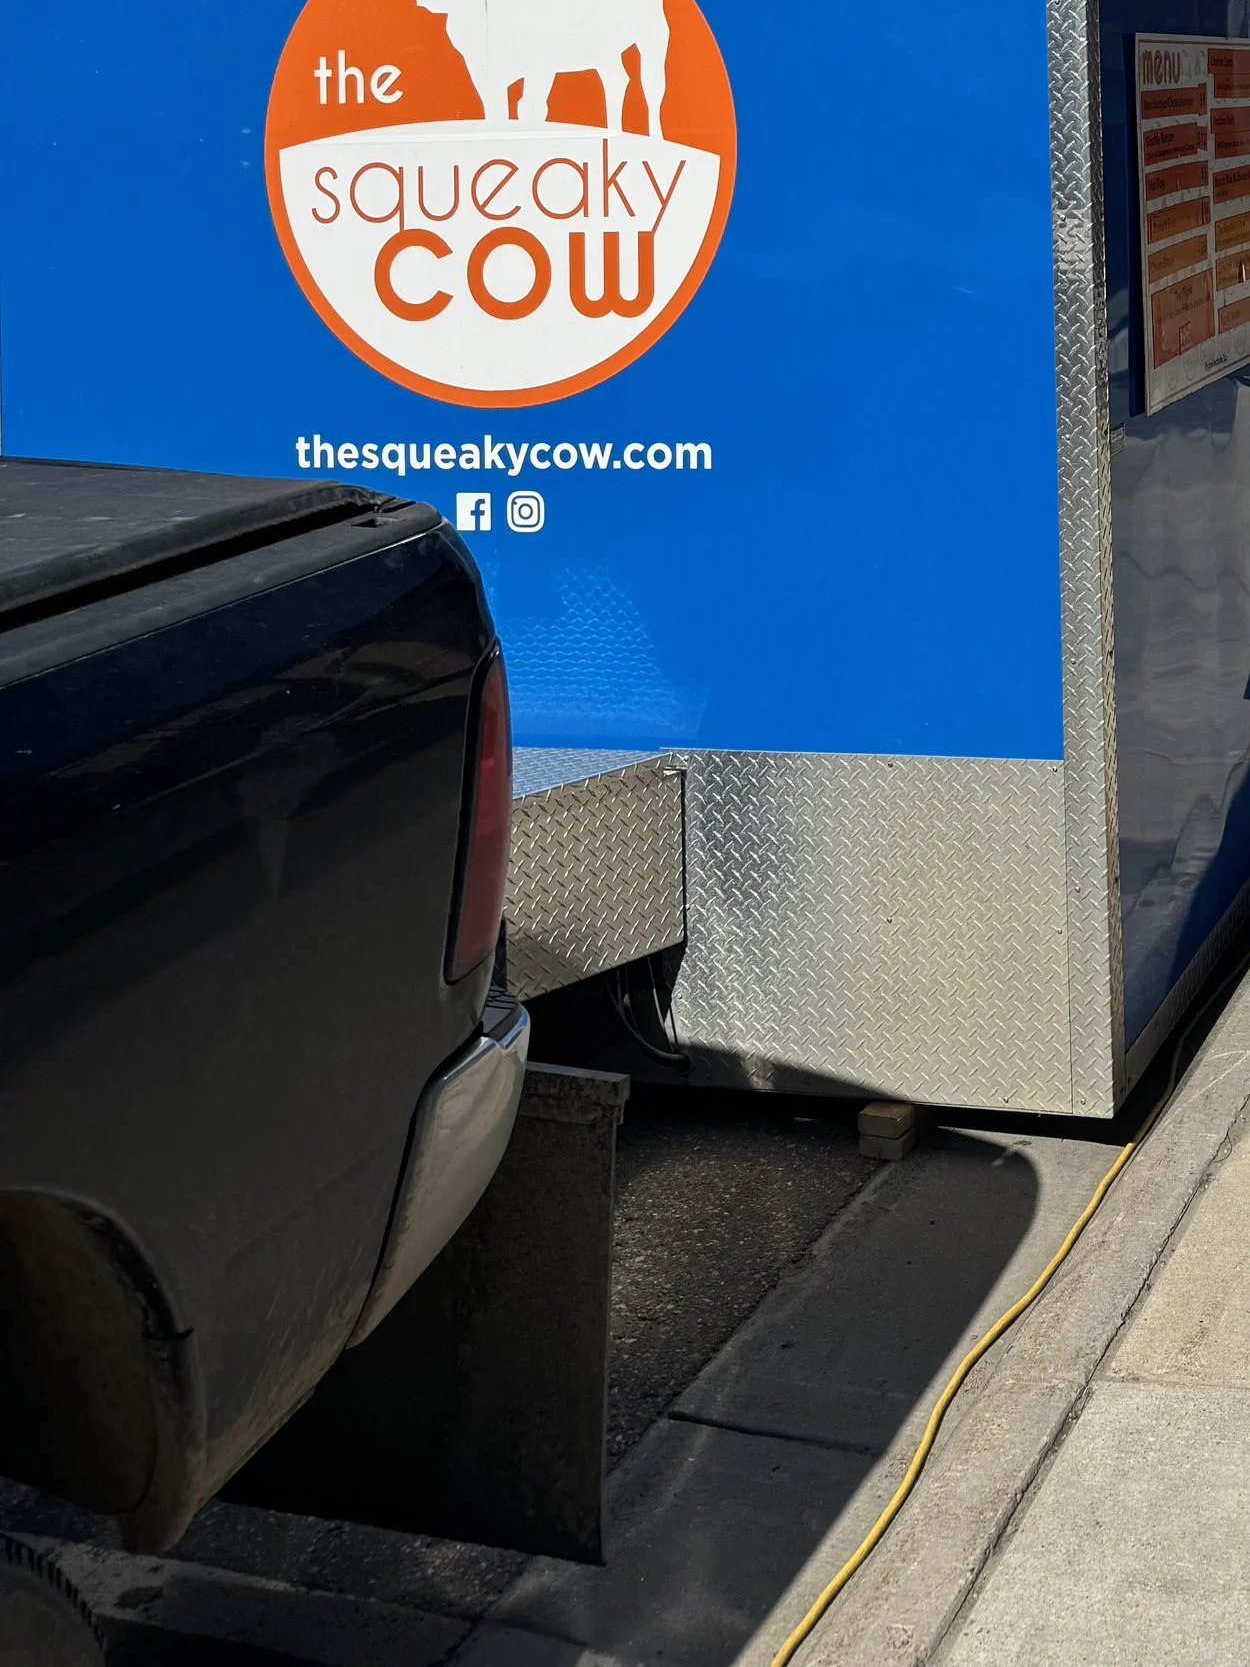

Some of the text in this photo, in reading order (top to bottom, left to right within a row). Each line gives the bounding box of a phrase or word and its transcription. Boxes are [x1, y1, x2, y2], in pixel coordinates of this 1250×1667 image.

[313, 49, 404, 105] the
[1142, 49, 1181, 85] menu
[311, 138, 687, 233] squeaky
[295, 434, 713, 476] thesqueakycow.com
